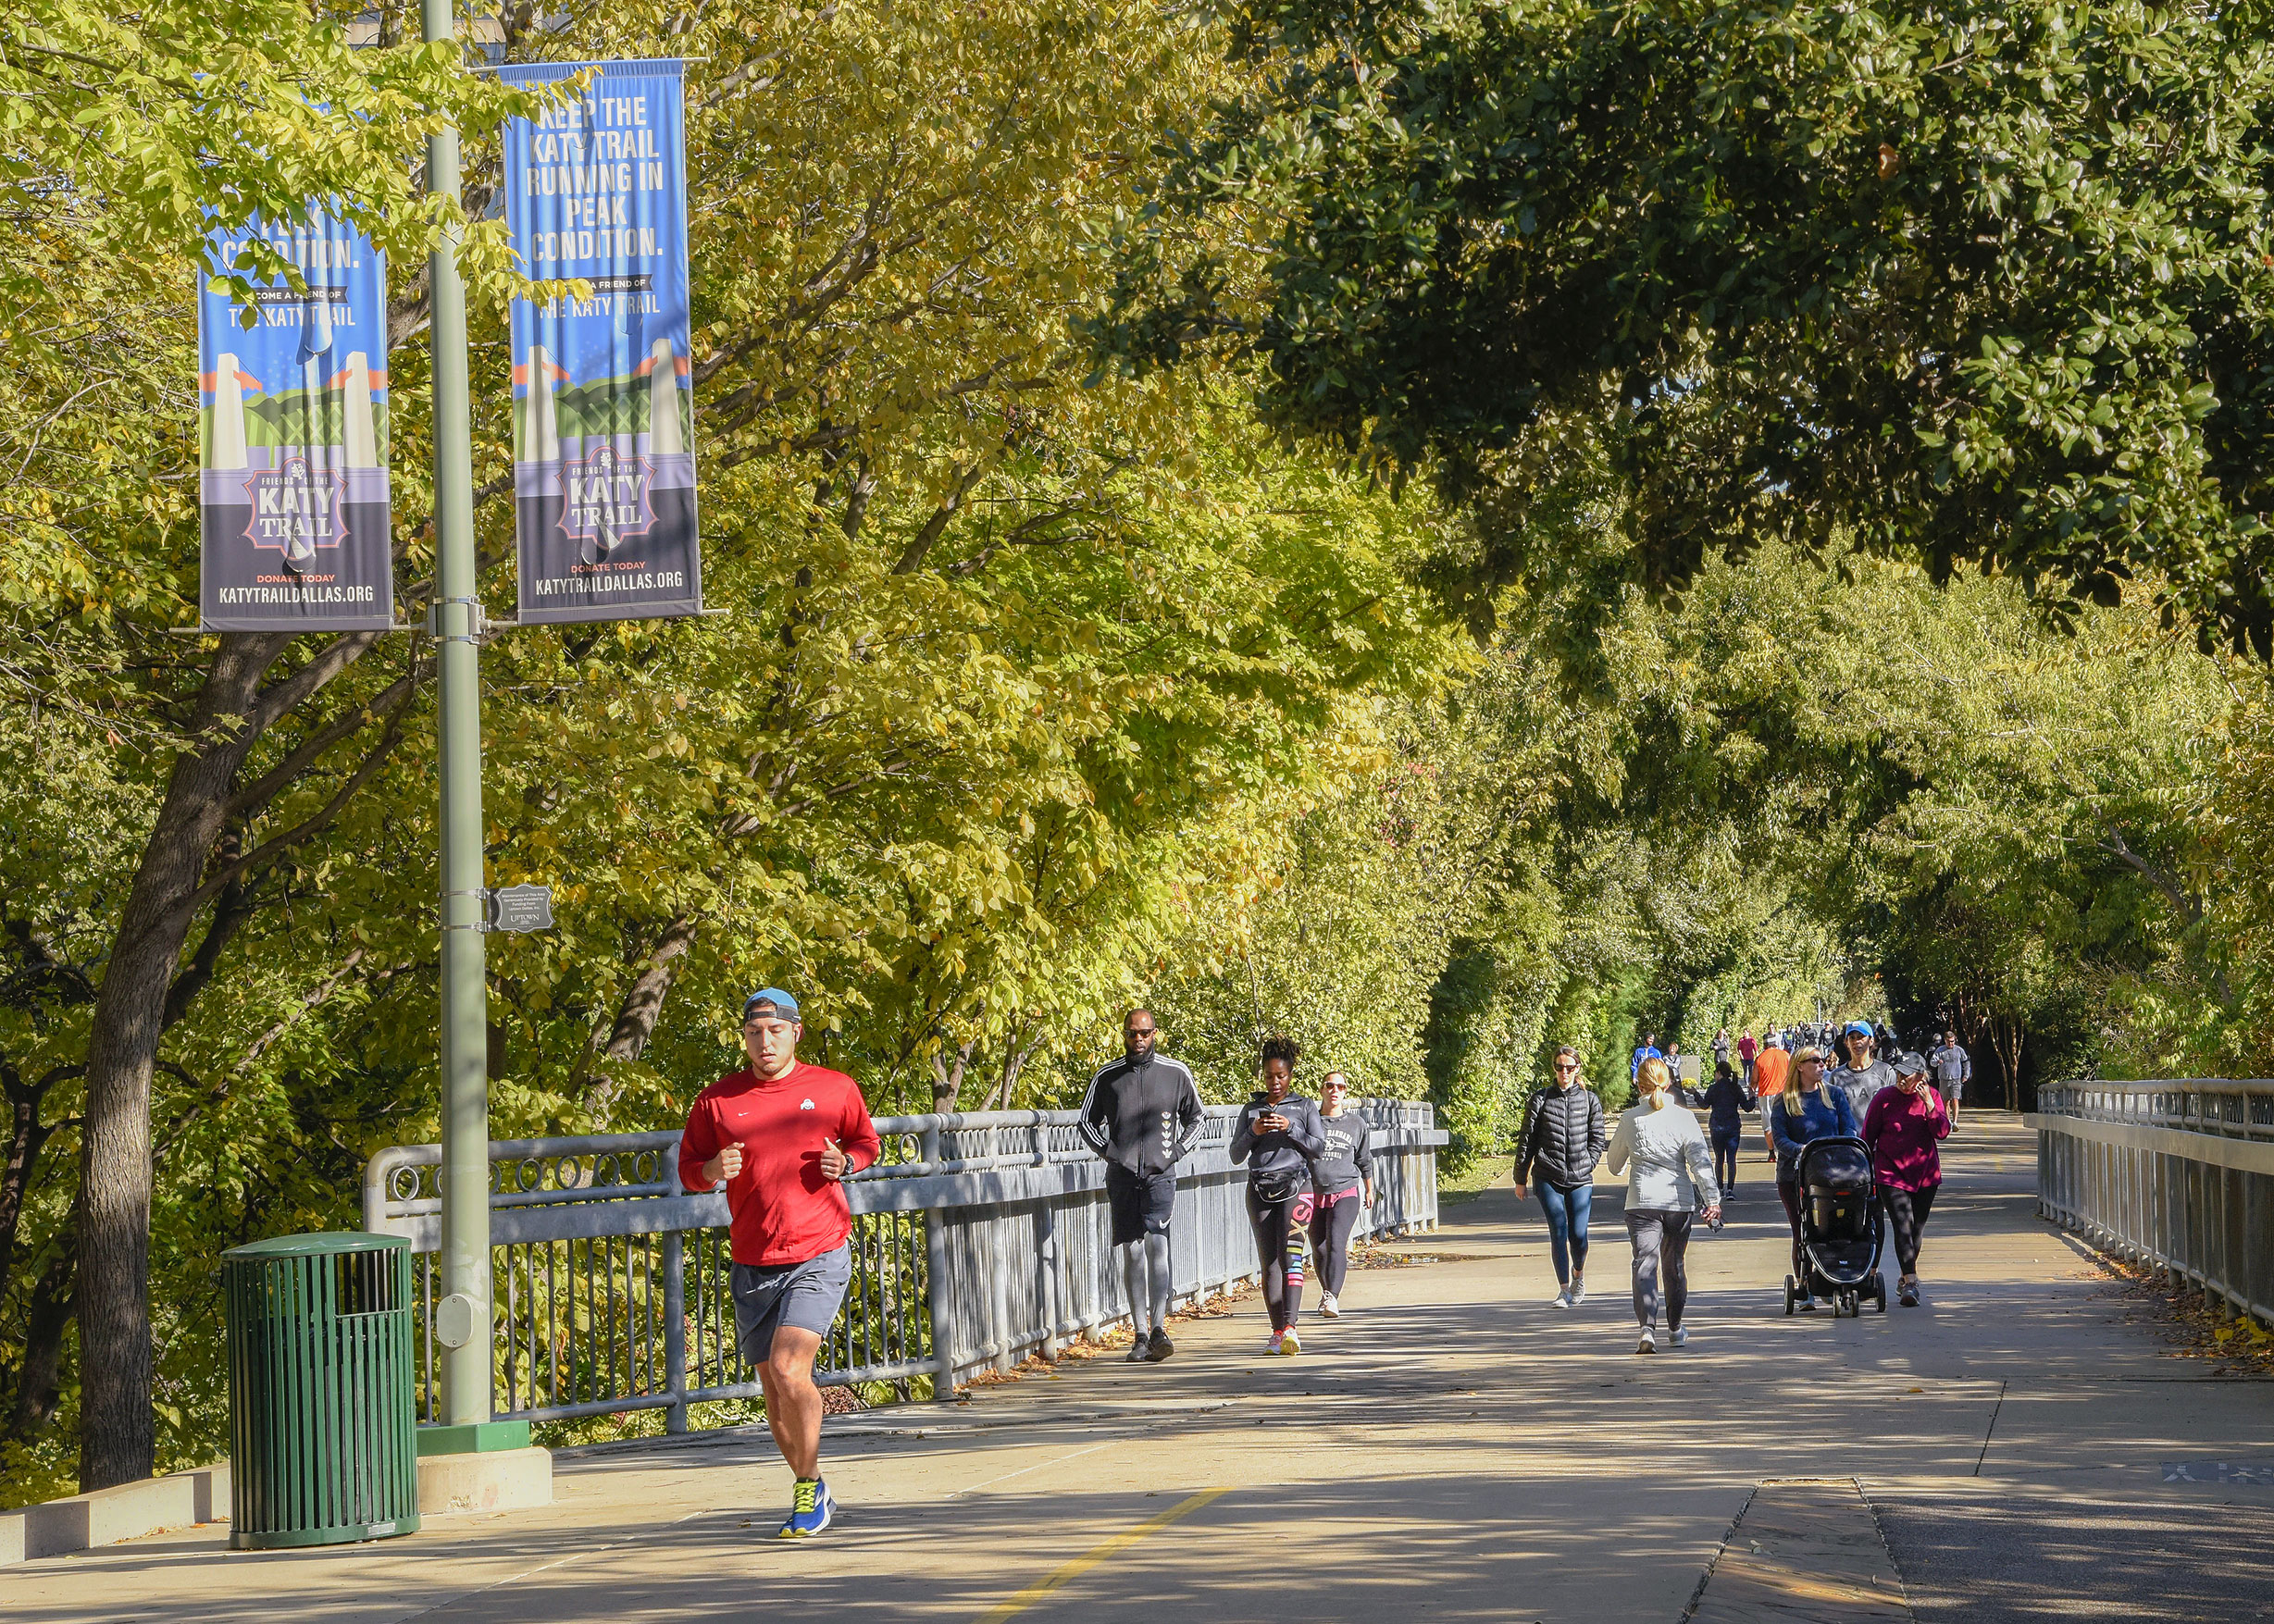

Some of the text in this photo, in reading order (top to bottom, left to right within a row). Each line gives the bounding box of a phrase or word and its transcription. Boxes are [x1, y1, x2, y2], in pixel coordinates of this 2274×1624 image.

[602, 96, 647, 127] THE
[529, 129, 660, 164] KATY TRAIL
[527, 161, 664, 197] RUNNING IN
[566, 195, 628, 228] PEAK
[531, 227, 664, 262] CONDITION.
[599, 279, 632, 289] FRIEND
[634, 279, 646, 287] OF
[329, 291, 342, 299] OF
[616, 294, 661, 315] TRAIL
[266, 307, 306, 327] KATY
[572, 465, 637, 476] FRIENDS OF THE
[261, 477, 294, 486] FRIENDS
[315, 477, 329, 485] THE
[570, 474, 643, 505] KATY
[259, 487, 335, 514] KATY
[571, 505, 642, 527] TRAIL
[259, 516, 332, 538] TRAIL
[571, 561, 646, 574] DONATE TODAY
[256, 574, 335, 583] DONATE TODAY
[535, 571, 683, 595] KATYTRAILDALLAS.ORG
[219, 585, 374, 604] KATYTRAILDALLAS.ORG
[511, 913, 540, 923] UPTOWN
